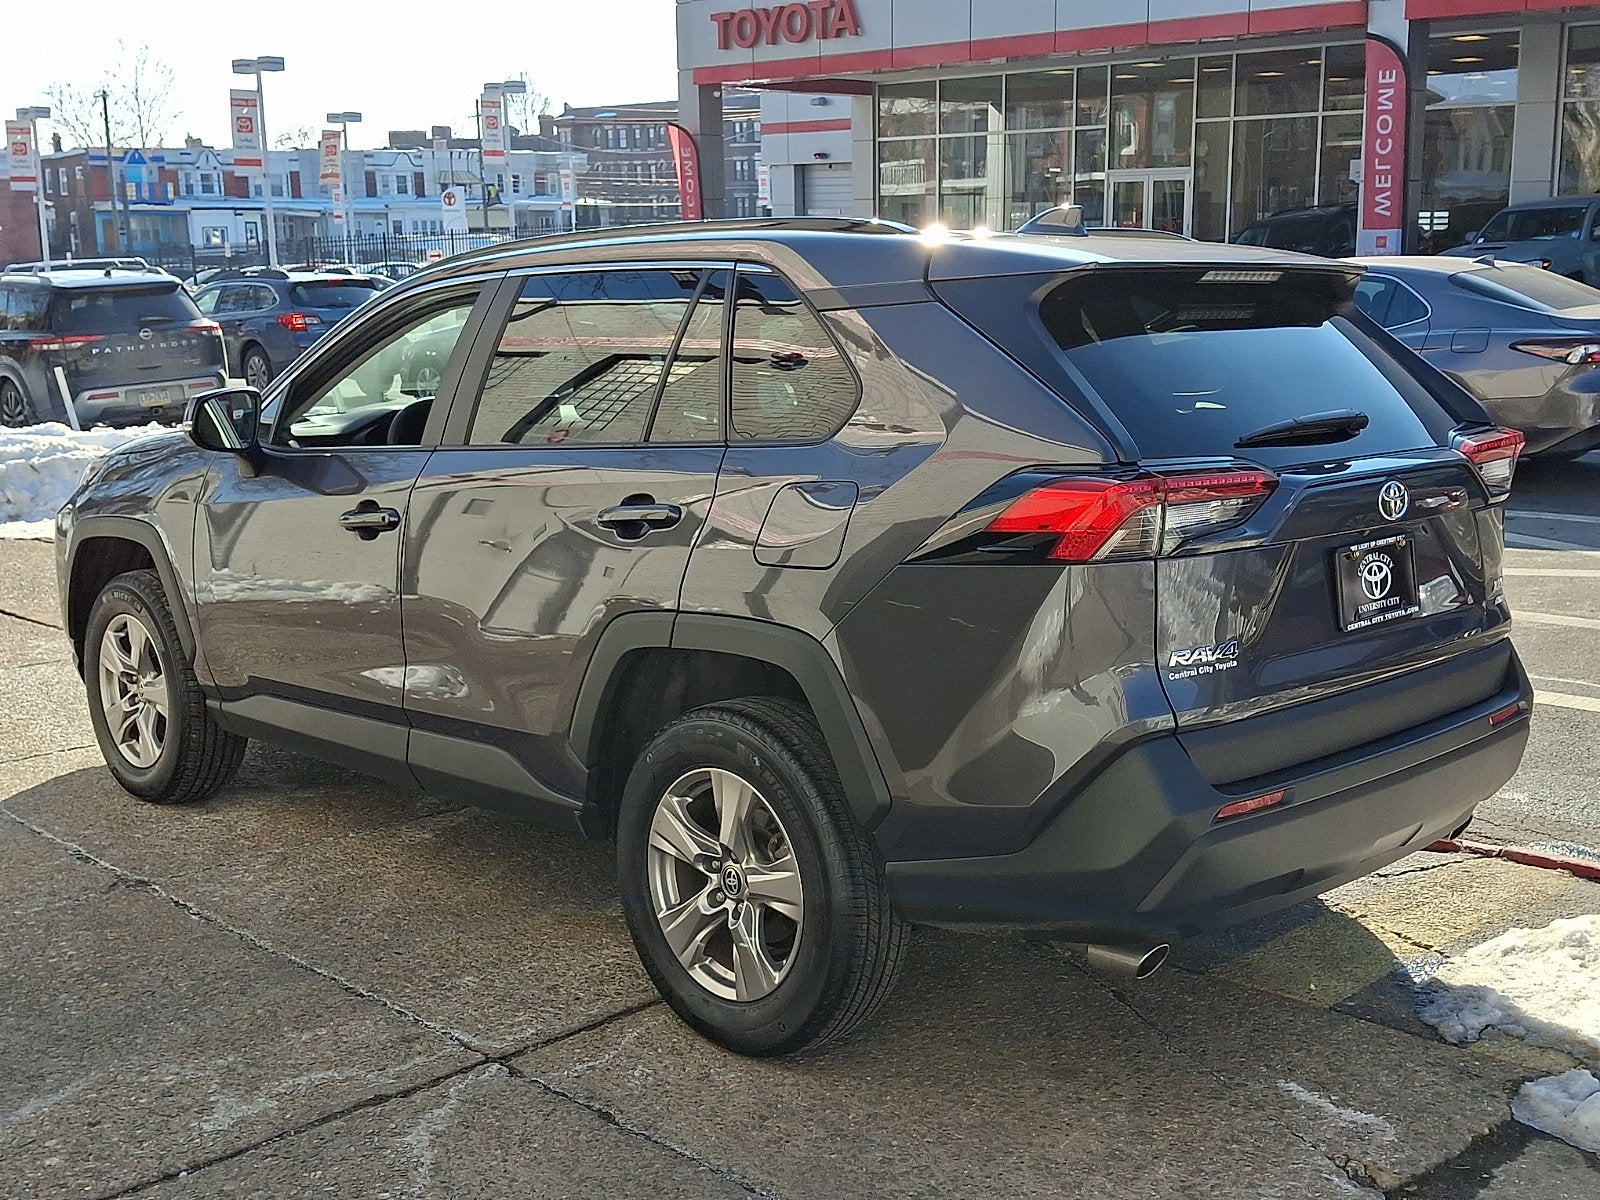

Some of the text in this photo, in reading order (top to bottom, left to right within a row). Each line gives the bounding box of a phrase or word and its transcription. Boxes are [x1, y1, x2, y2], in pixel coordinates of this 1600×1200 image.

[711, 0, 858, 50] TOYOTA
[92, 338, 198, 355] PATHFINDER
[1357, 551, 1395, 576] CENTRAL CITY
[1358, 596, 1400, 614] UNIVERSITY CITY
[1347, 619, 1372, 631] CENTRAL
[1371, 616, 1385, 625] CITY
[1168, 640, 1239, 667] RAV4
[1168, 660, 1238, 681] Central City Toyota
